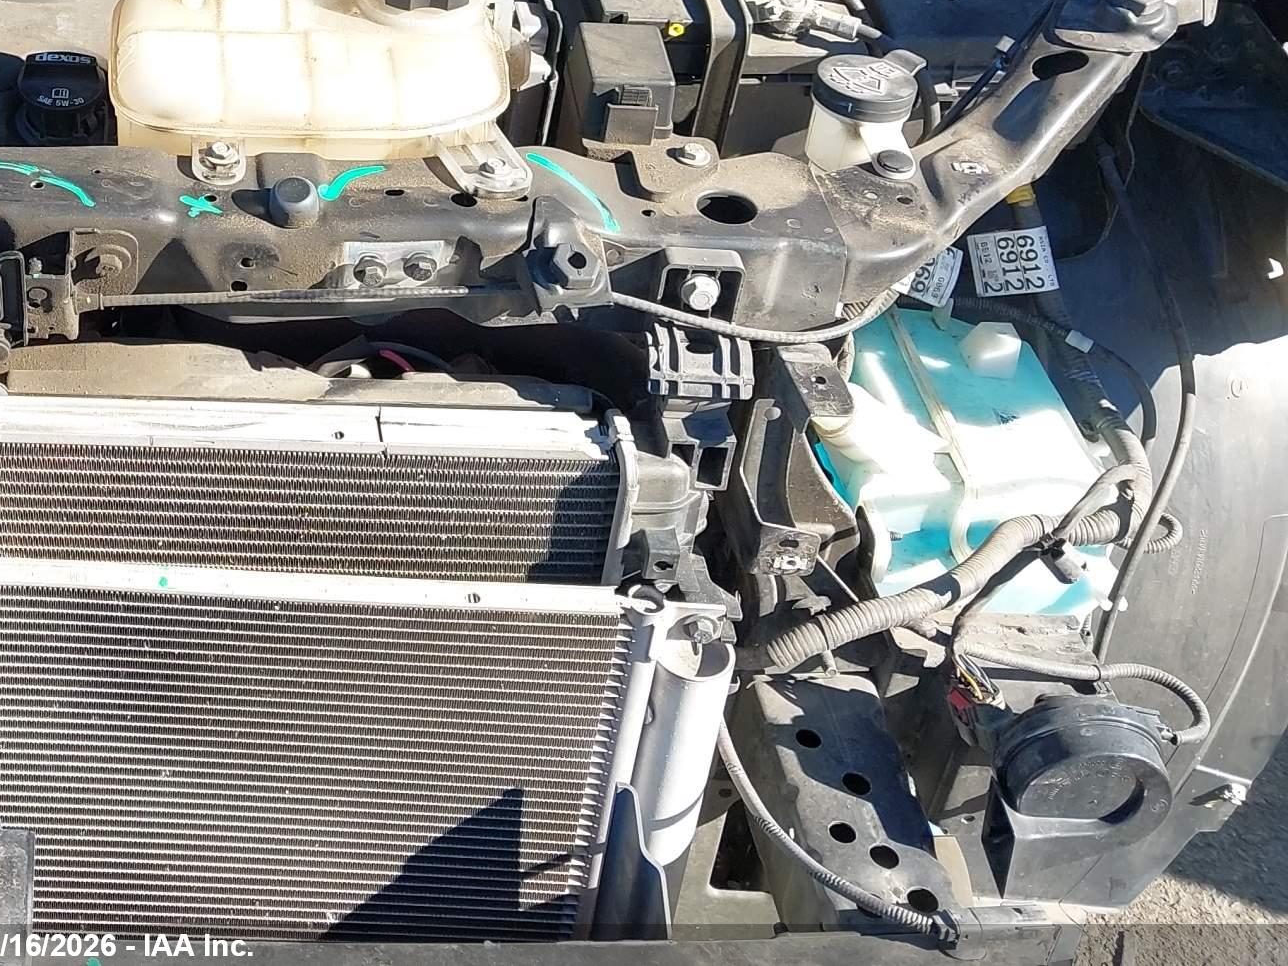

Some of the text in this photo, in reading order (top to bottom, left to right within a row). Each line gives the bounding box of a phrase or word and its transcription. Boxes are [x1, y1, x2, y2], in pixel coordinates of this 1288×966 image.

[34, 52, 91, 65] dexos
[37, 95, 54, 107] SAE
[997, 236, 1025, 292] 6912
[1016, 234, 1046, 290] 6912
